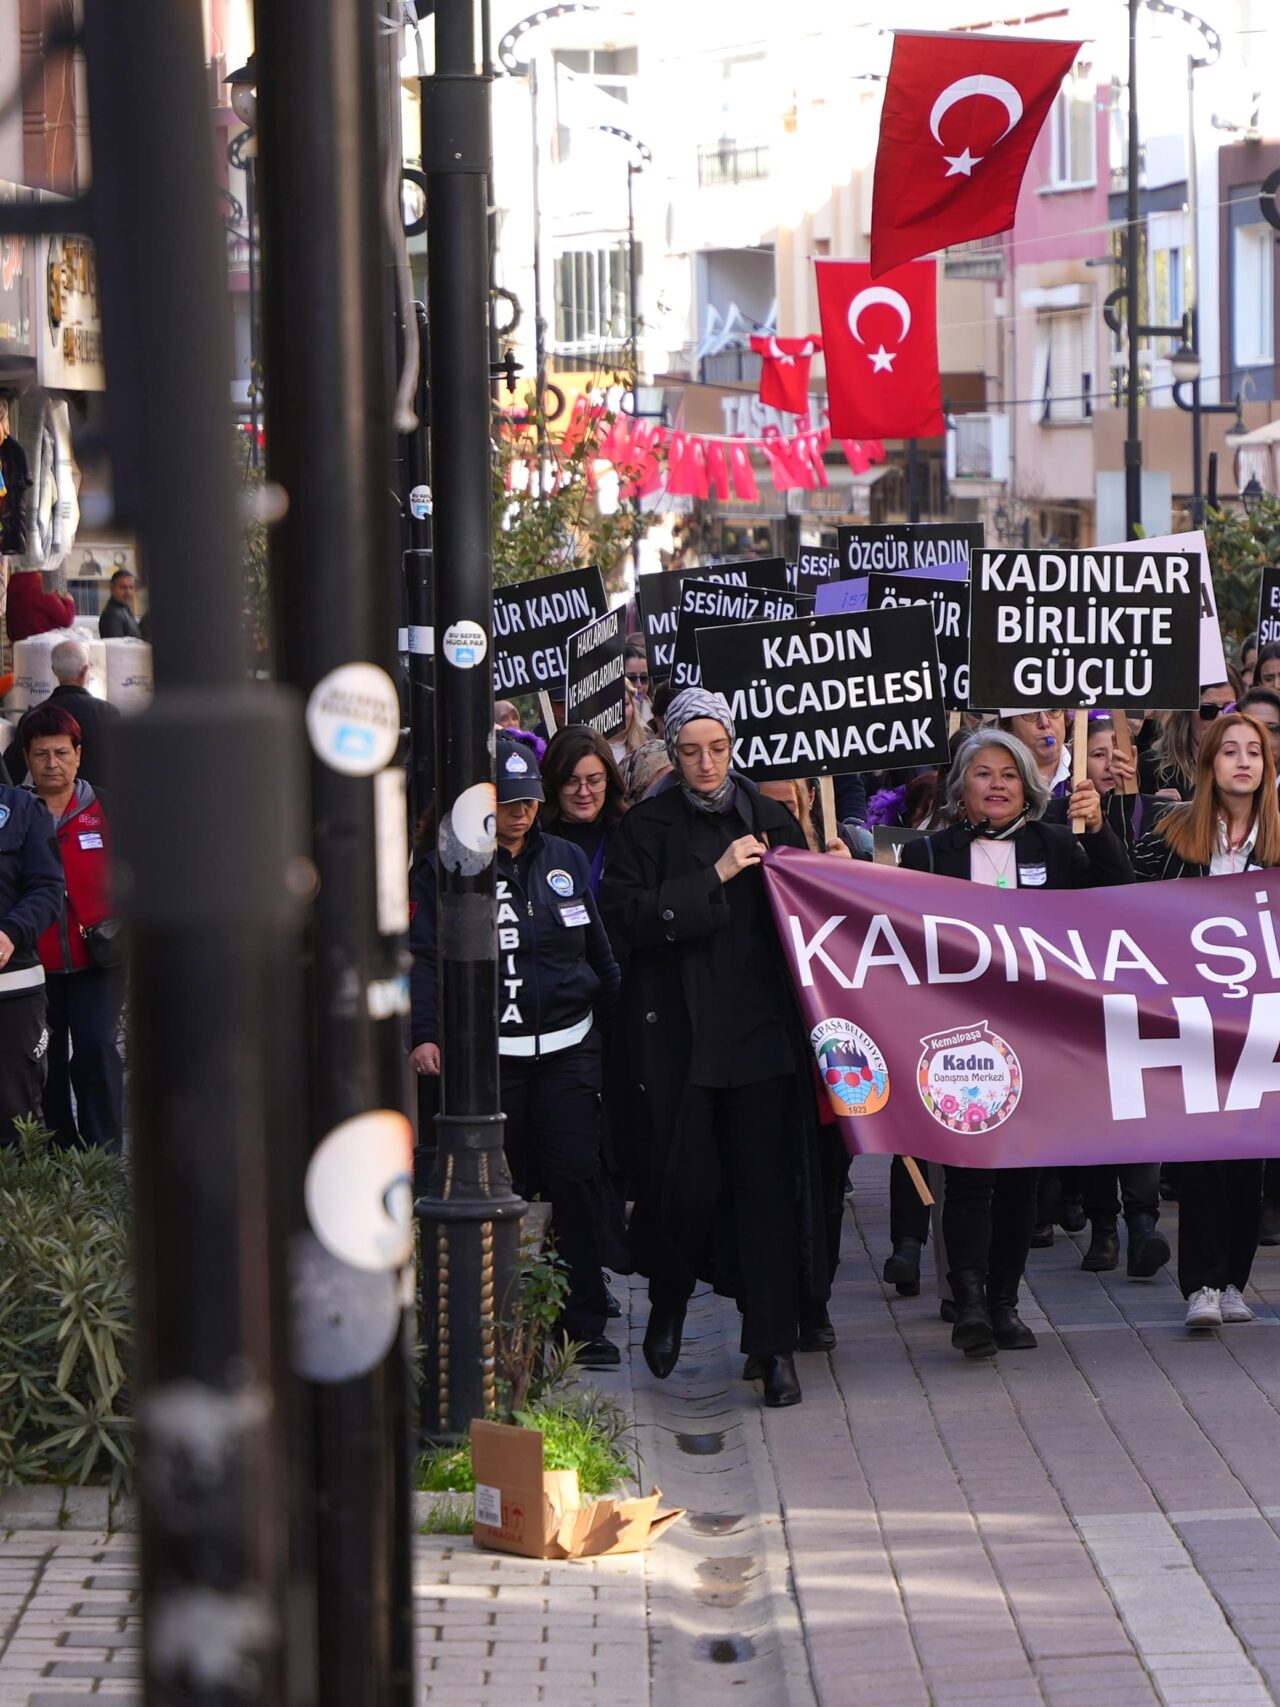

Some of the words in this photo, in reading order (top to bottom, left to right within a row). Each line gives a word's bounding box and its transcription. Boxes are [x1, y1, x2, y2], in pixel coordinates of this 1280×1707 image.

[848, 534, 909, 571] ÖZGÜR
[913, 539, 970, 568] KADIN
[981, 553, 1191, 593] KADINLAR
[683, 588, 759, 619] SESİMİZ
[997, 596, 1172, 645] BİRLİKTE
[577, 613, 618, 658] HAKLARIMIZA
[762, 627, 872, 669] KADIN
[569, 681, 577, 710] VE
[577, 654, 624, 705] HAYATLARIMIZA
[713, 661, 933, 721] MÜCADELESİ
[1013, 648, 1153, 705] GÜÇLÜ
[728, 717, 935, 769] KAZANACAK
[496, 881, 523, 1024] ZABITA
[789, 913, 1169, 990] KADINA
[811, 1020, 844, 1046] ALPAŞA
[931, 1030, 982, 1050] Kemalpaşa
[934, 1073, 969, 1084] Danışma
[971, 1072, 1005, 1083] Merkezi
[943, 1054, 994, 1071] Kadın
[848, 1106, 867, 1114] 1923
